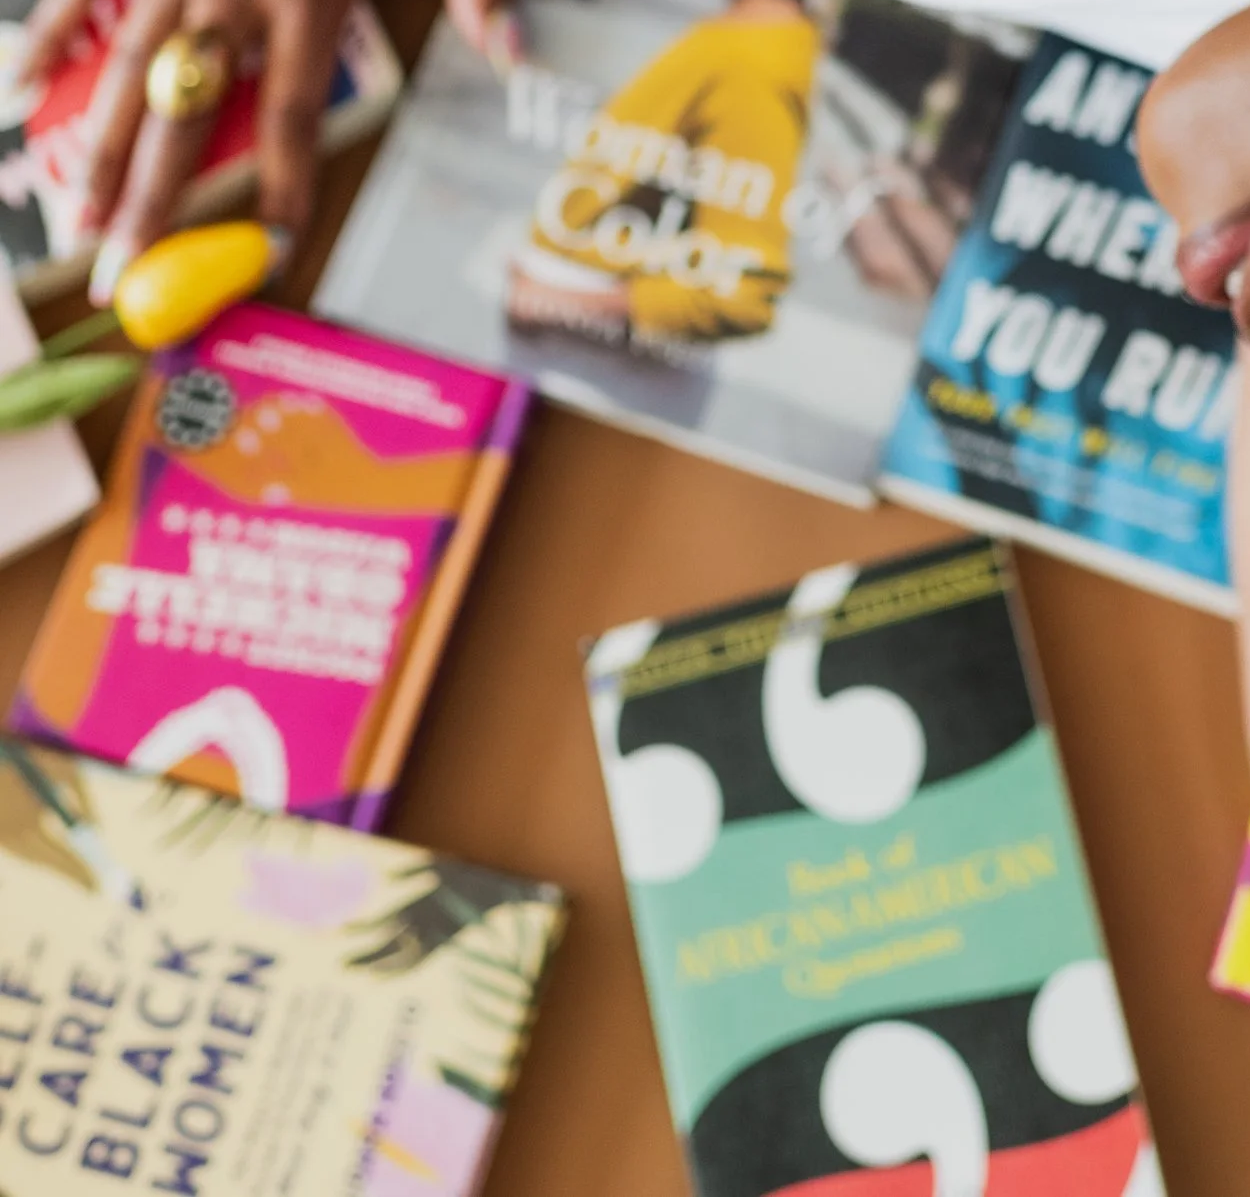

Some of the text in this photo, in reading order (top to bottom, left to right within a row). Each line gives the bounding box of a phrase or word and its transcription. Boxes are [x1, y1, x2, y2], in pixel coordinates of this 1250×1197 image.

[1025, 48, 1145, 148] AN
[506, 68, 895, 261] Woman of
[534, 169, 765, 295] Color
[950, 278, 1108, 393] YOU
[87, 561, 397, 656] MICHELLE
[786, 846, 872, 900] Book
[16, 963, 125, 1158] CARE
[78, 930, 210, 1179] BLACK
[150, 945, 277, 1197] WOMEN
